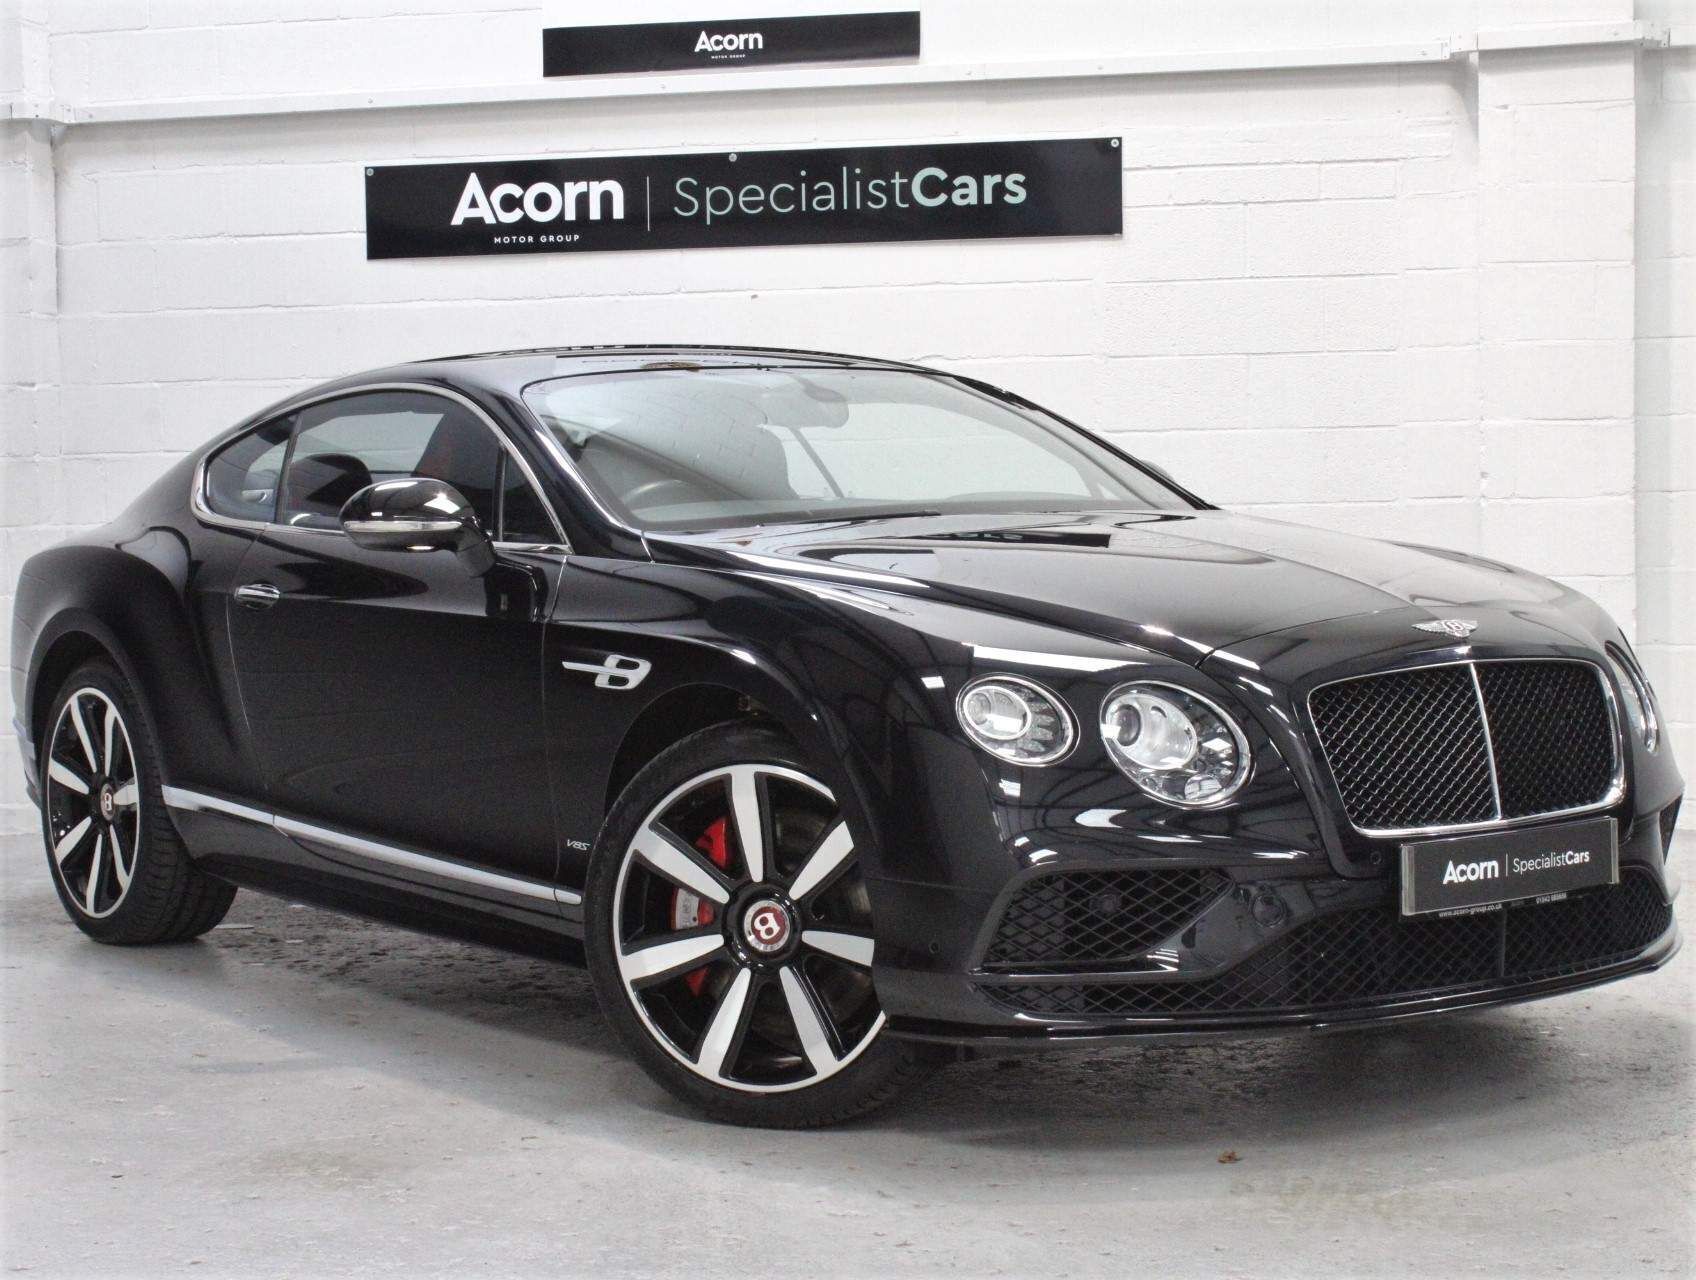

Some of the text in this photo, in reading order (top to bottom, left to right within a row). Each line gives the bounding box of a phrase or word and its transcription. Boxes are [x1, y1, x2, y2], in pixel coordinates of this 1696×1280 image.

[694, 30, 764, 53] Acorn
[450, 165, 1028, 226] Acorn SpecialistCars
[493, 234, 580, 244] MOTOR GROUP
[1442, 850, 1590, 885] Acorn SpecialistCars
